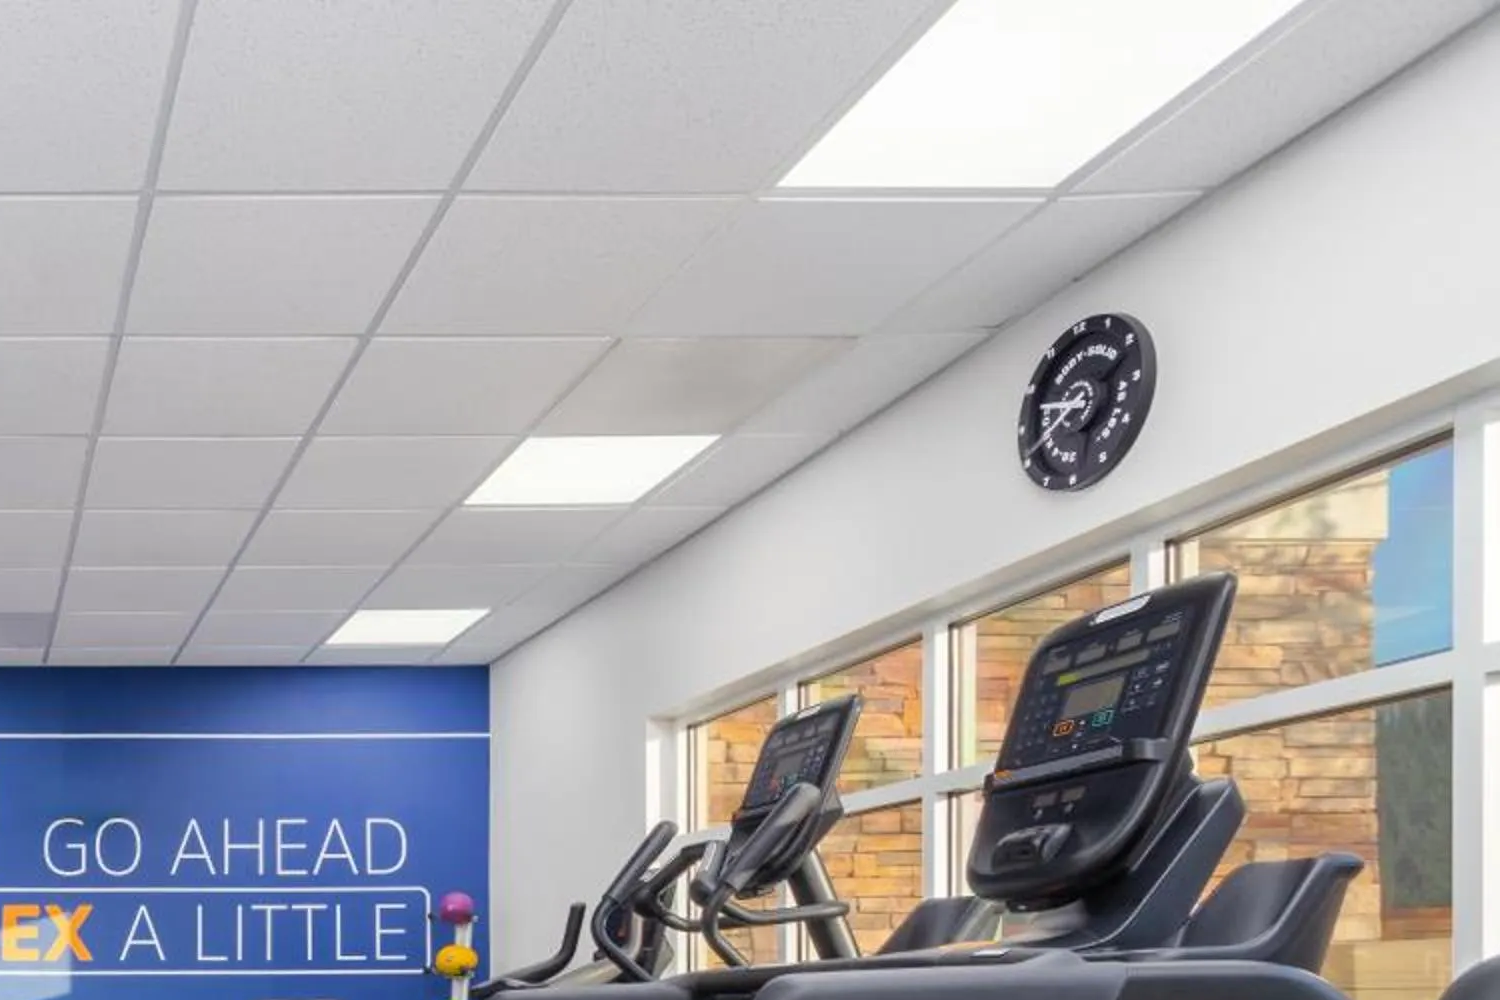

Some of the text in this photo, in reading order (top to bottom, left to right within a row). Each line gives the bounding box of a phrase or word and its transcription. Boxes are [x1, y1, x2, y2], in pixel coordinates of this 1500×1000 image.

[43, 817, 407, 876] GO AHEAD
[120, 905, 165, 961] A
[197, 904, 407, 961] LITTLE
